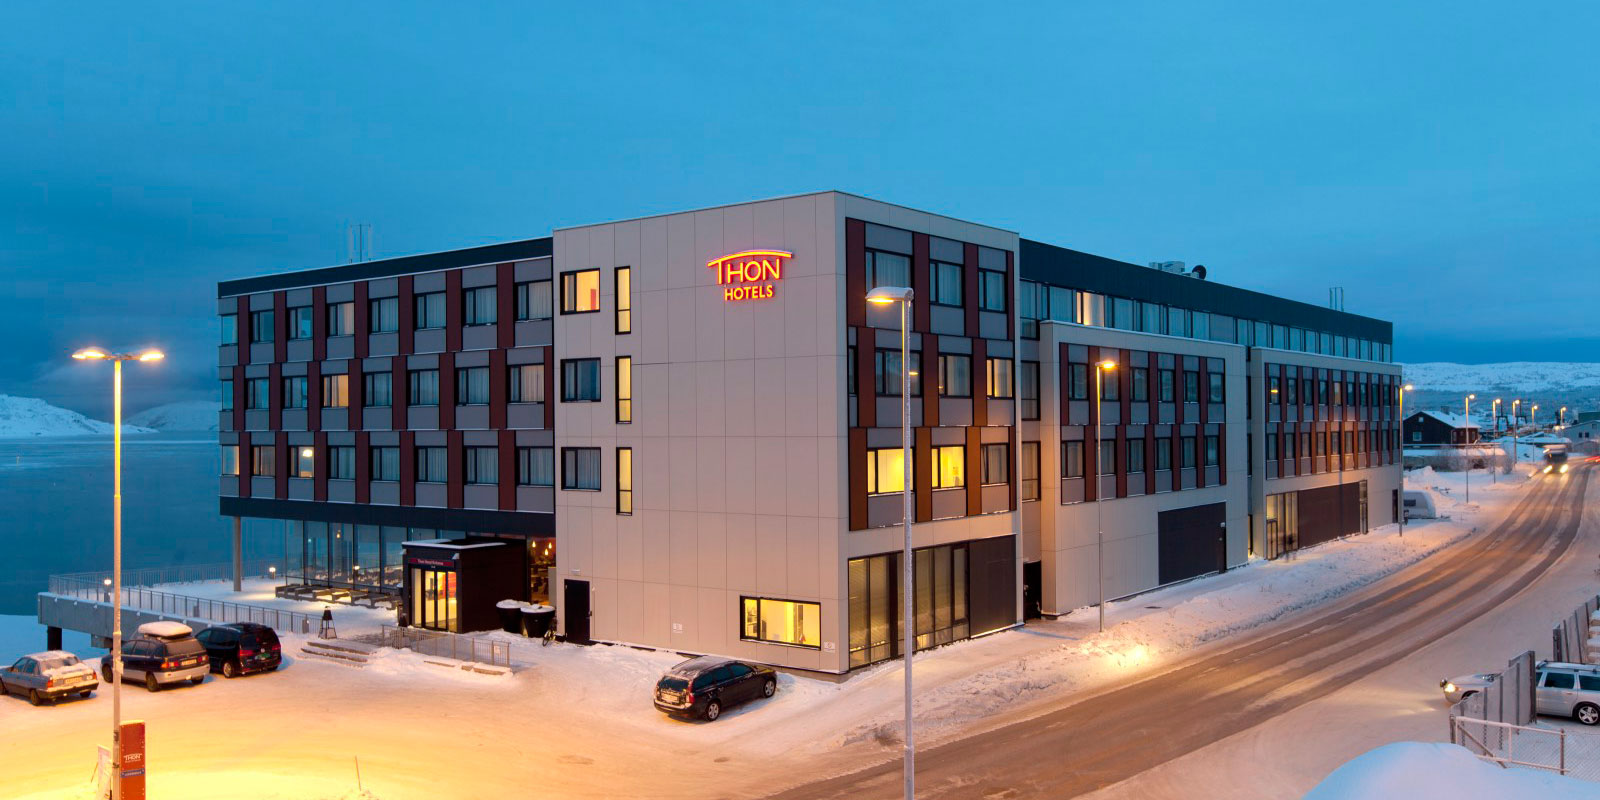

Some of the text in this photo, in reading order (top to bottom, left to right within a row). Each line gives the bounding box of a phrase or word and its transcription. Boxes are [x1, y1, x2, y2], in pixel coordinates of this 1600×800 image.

[707, 249, 792, 284] THON
[724, 284, 774, 301] HOTELS
[123, 752, 142, 761] THON
